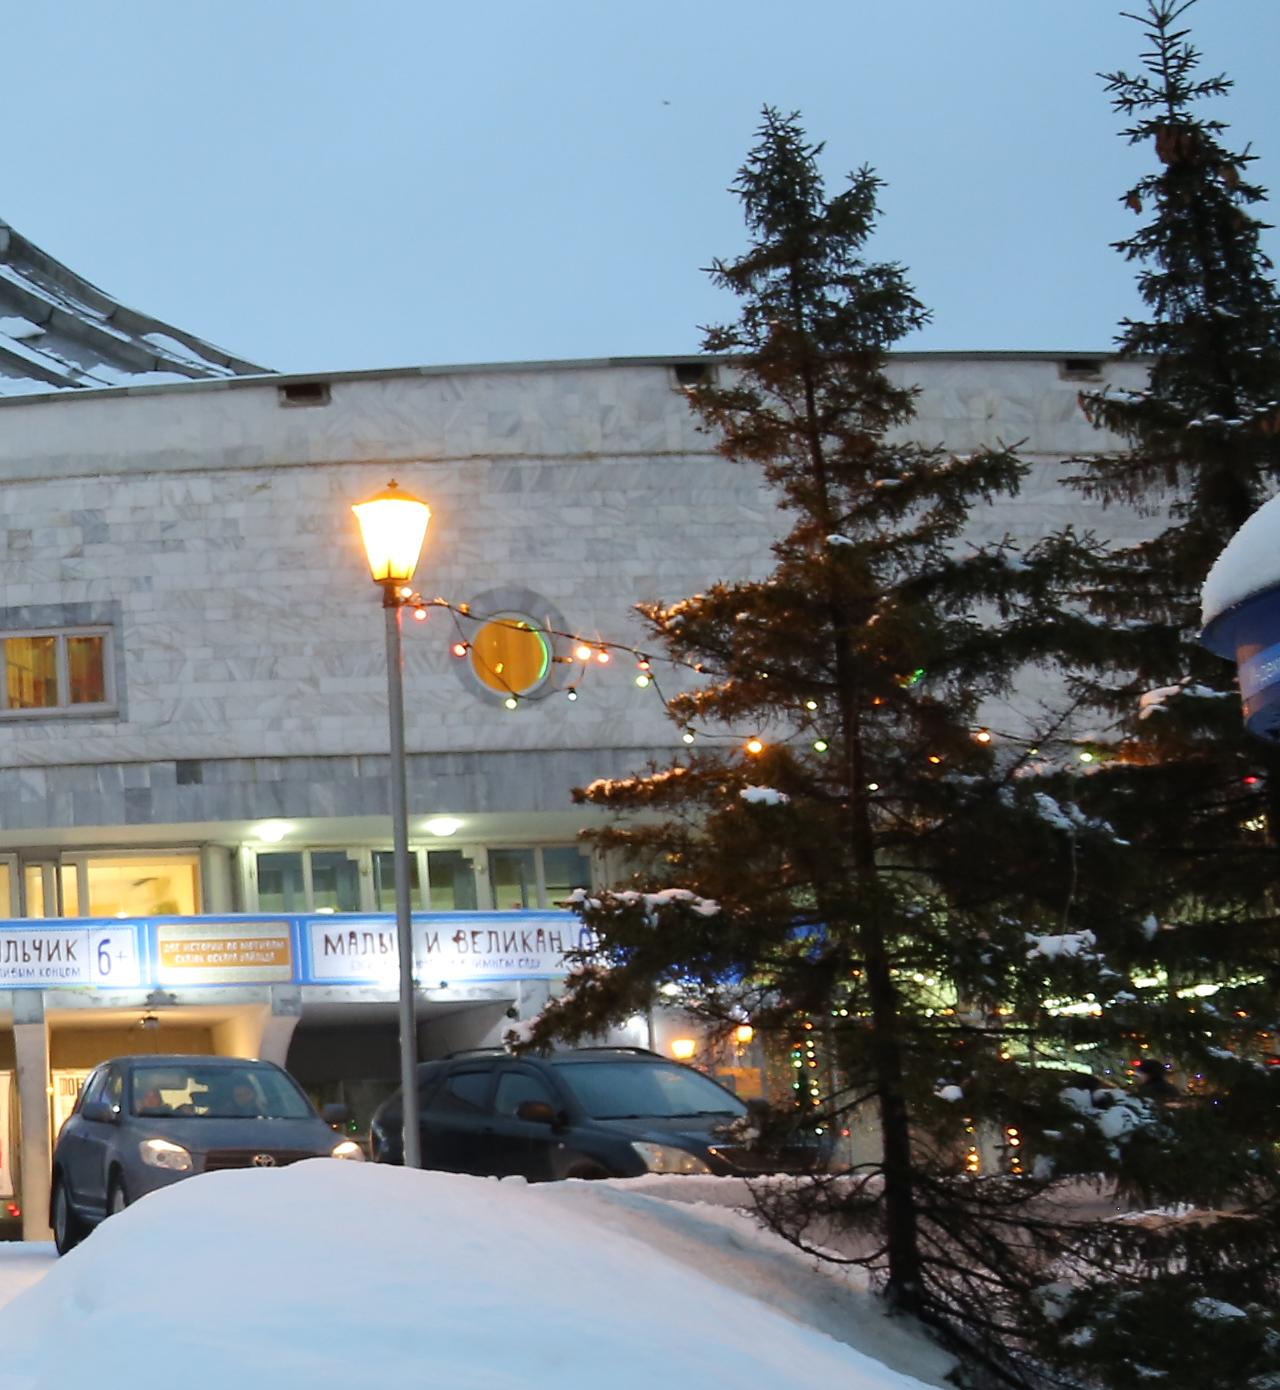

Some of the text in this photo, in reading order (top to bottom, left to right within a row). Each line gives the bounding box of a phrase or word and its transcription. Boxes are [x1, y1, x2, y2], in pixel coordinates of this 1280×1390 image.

[324, 931, 400, 956] МАЛЫ
[452, 928, 563, 956] ВЕЛИКАН
[97, 938, 128, 976] 6+
[40, 967, 80, 978] КОНЦОМ
